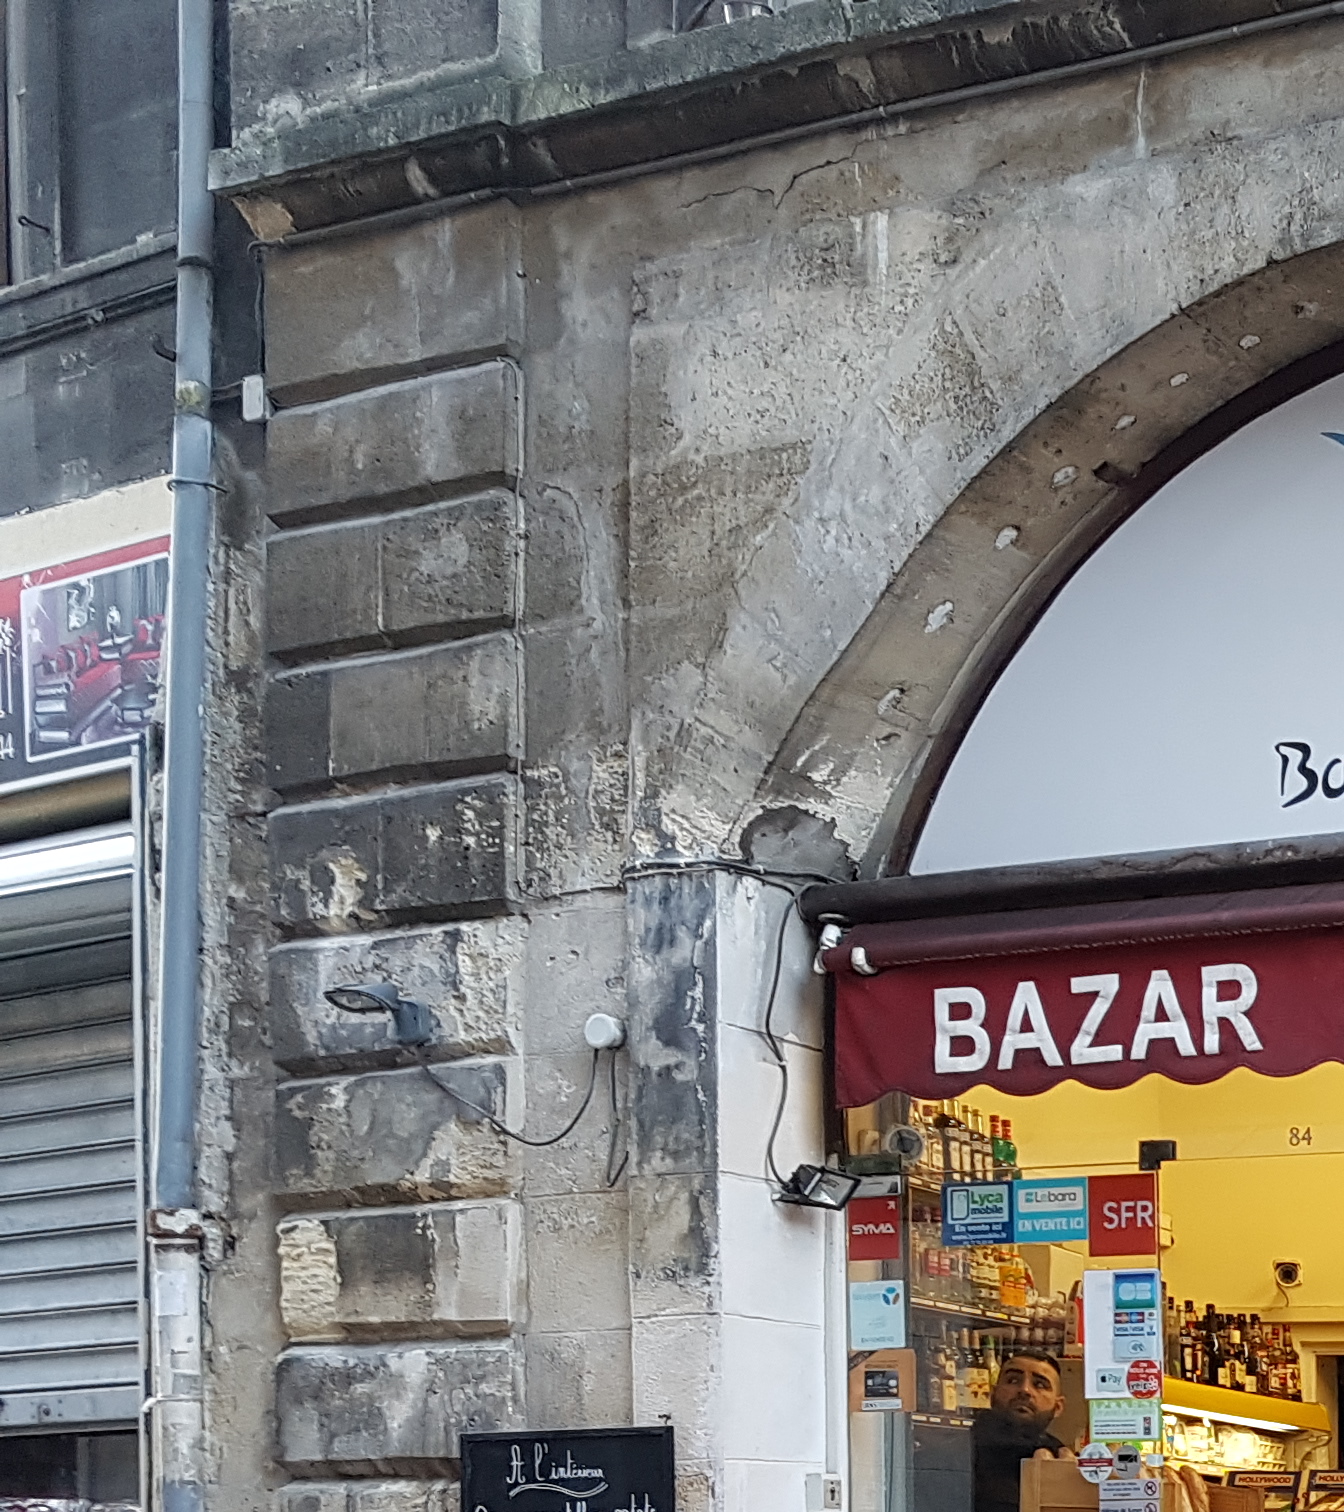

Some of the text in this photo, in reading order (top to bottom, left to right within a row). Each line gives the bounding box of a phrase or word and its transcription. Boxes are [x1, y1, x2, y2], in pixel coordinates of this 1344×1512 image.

[933, 962, 1263, 1074] BAZAR
[1288, 1127, 1313, 1147] 84
[971, 1191, 1003, 1206] Lyca
[1035, 1191, 1077, 1203] Lebara
[971, 1205, 1003, 1215] mobile
[1103, 1200, 1154, 1229] SFR
[851, 1224, 895, 1235] SYMA
[1018, 1218, 1084, 1232] EN VENTE ICI
[1238, 1474, 1292, 1485] HOLLYWOOD
